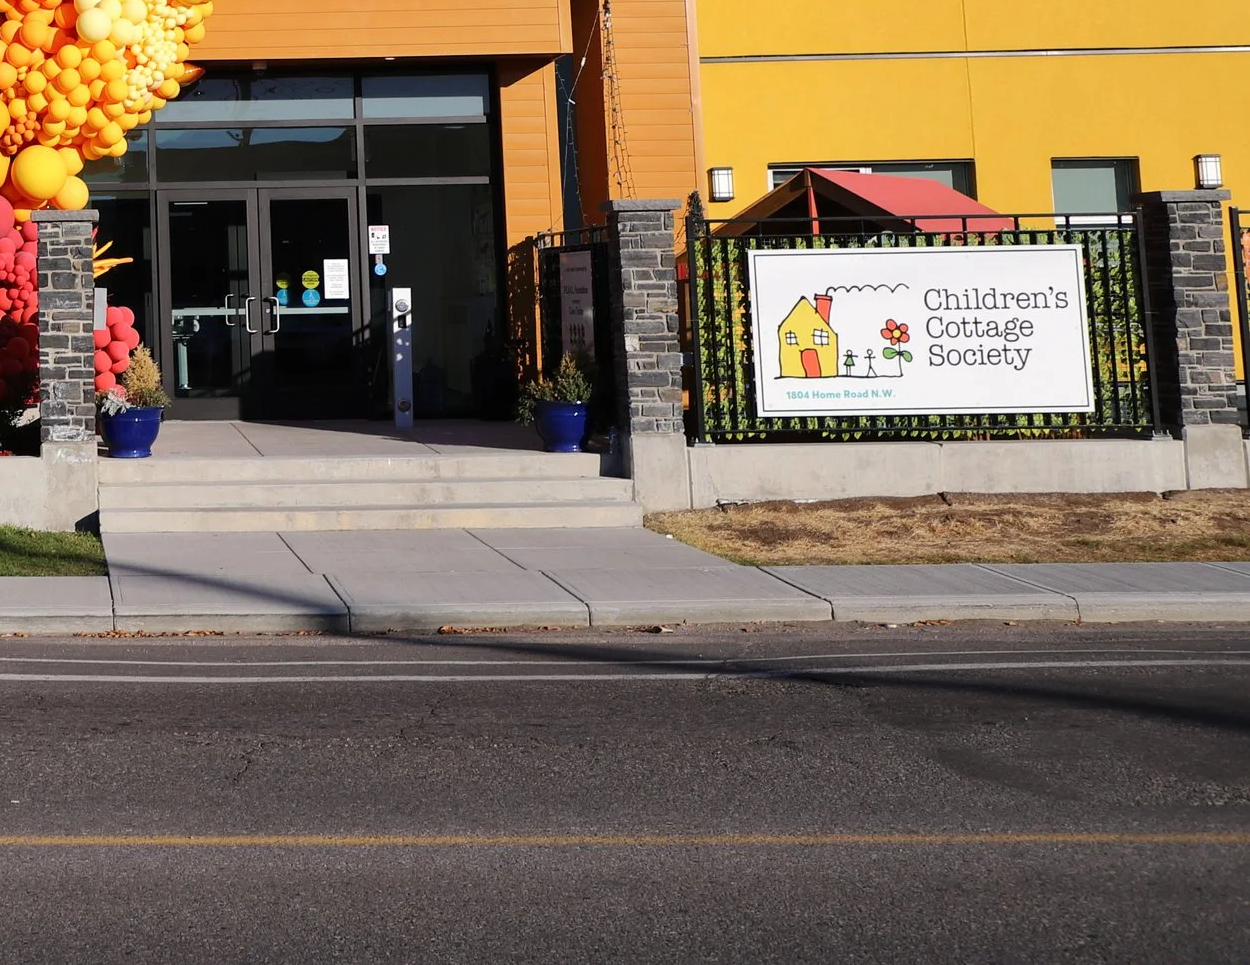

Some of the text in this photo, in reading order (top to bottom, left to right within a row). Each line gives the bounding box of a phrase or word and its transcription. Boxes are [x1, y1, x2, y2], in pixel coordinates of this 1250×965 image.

[923, 286, 1069, 311] Children's
[925, 316, 1035, 342] Cottage
[928, 343, 1033, 371] Society
[786, 389, 897, 400] 1804 Home Road N.W.
